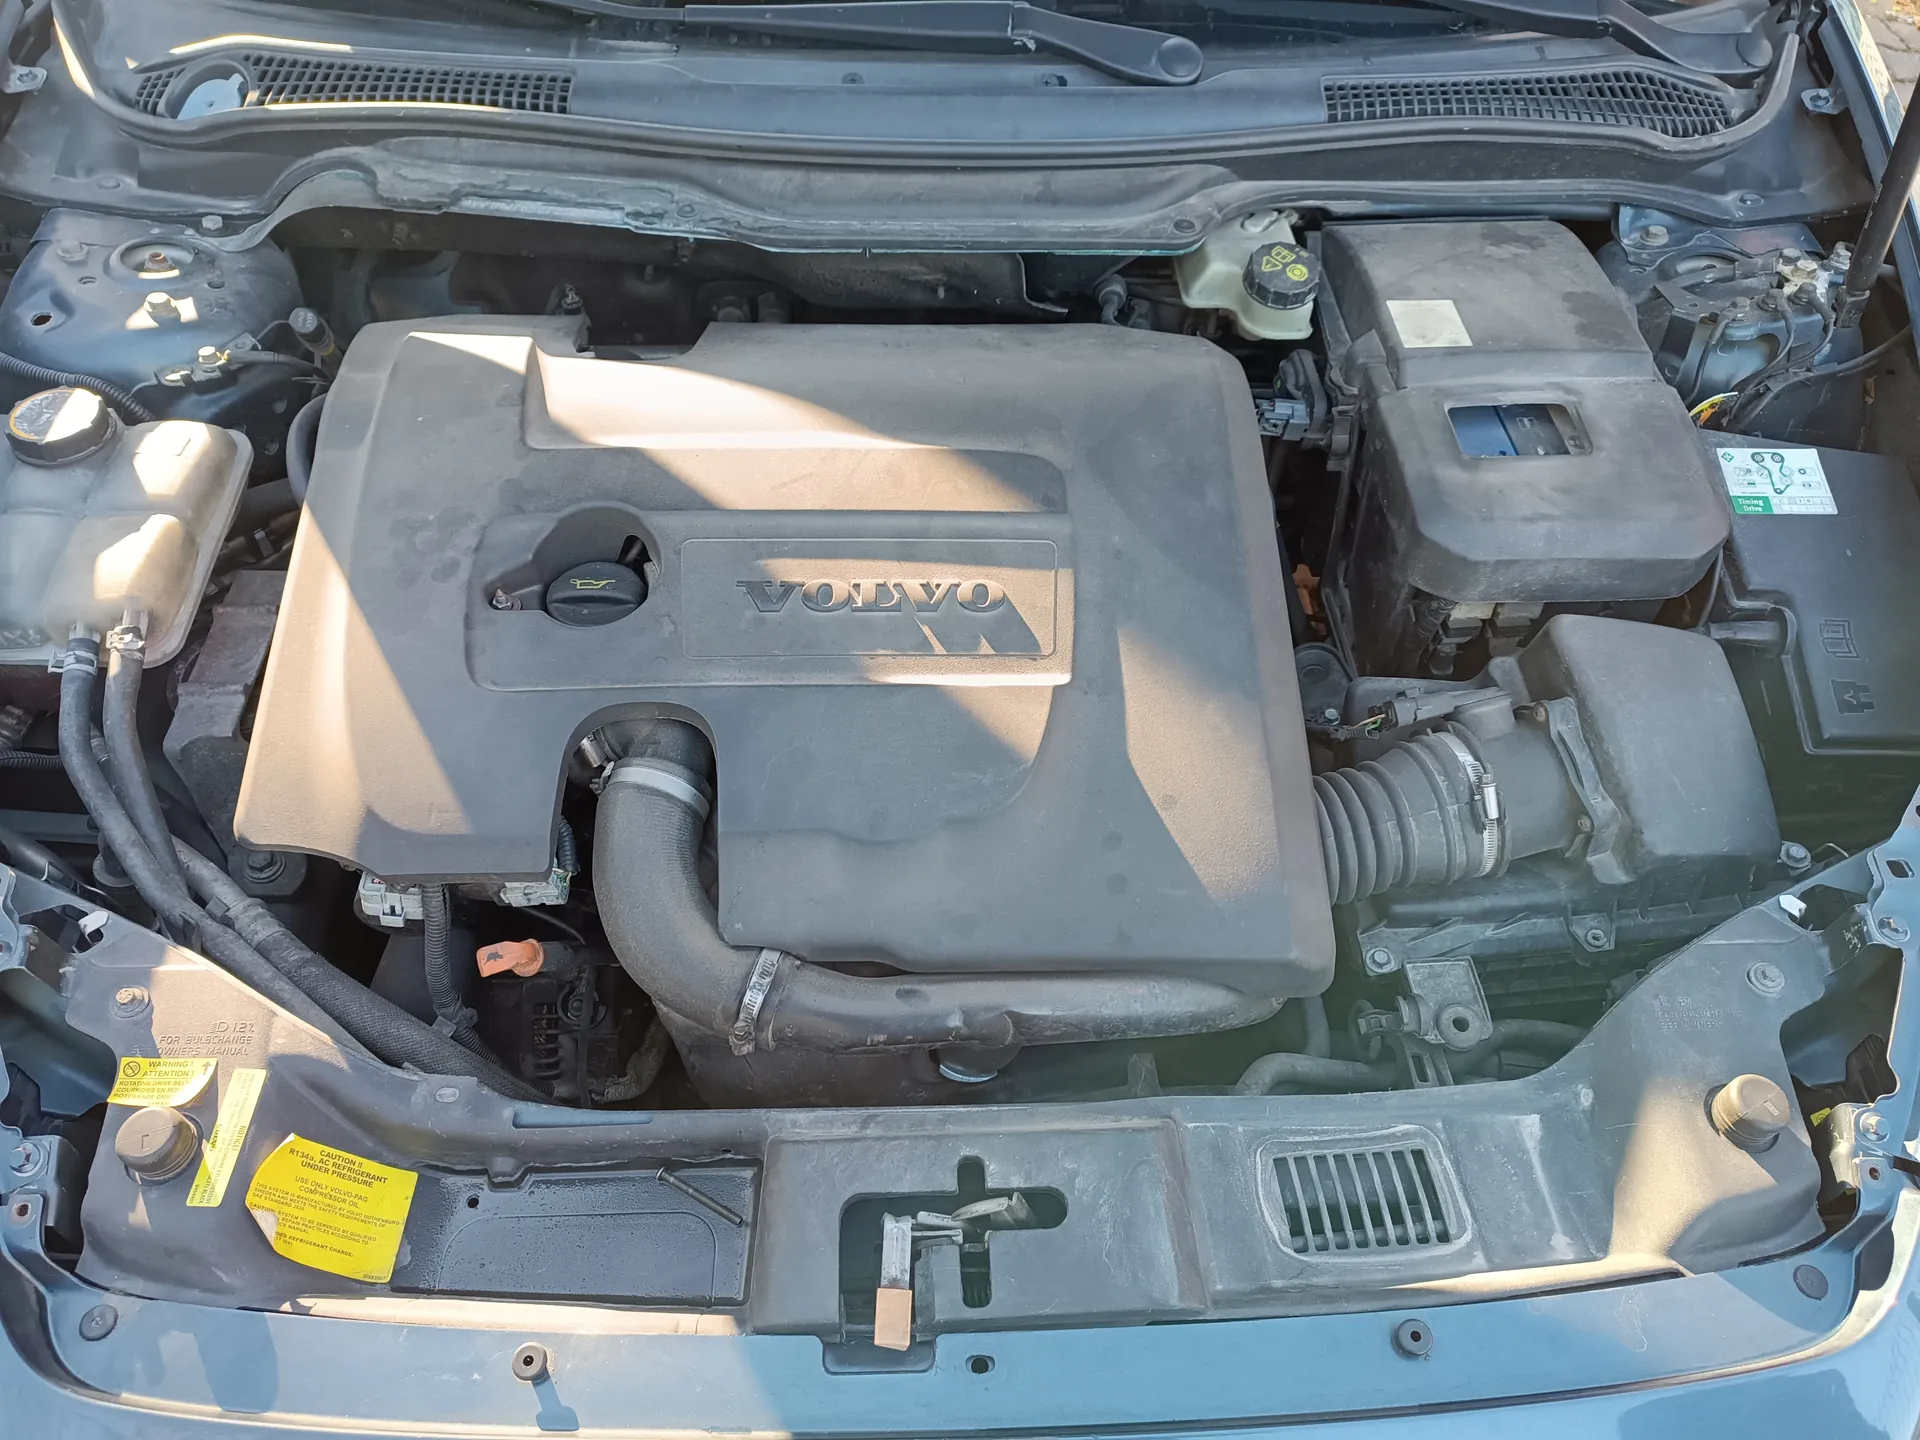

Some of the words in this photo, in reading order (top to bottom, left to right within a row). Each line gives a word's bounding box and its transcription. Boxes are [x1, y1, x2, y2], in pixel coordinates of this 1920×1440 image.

[1738, 498, 1764, 506] Timing
[736, 579, 1006, 614] VOLVO
[158, 1046, 200, 1055] OWNERS
[206, 1047, 248, 1055] MANUAL
[159, 1035, 180, 1044] FOR
[185, 1035, 252, 1044] BULBCHANGE
[289, 1148, 316, 1163] R134a,
[319, 1158, 329, 1166] AC
[332, 1161, 388, 1184] REFRIGERANT
[320, 1150, 356, 1166] CAUTION
[301, 1161, 330, 1174] UNDER
[332, 1170, 374, 1188] PRESSURE
[263, 1195, 292, 1207] STANDARD
[268, 1185, 289, 1196] SYSTEM
[296, 1194, 337, 1210] MANUFACTURED
[345, 1209, 362, 1217] VOLVO
[295, 1176, 309, 1184] USE
[311, 1180, 329, 1190] ONLY
[331, 1186, 368, 1202] VOLVO-PAG
[299, 1186, 347, 1204] COMPRESSOR
[253, 1187, 276, 1197] SWEDEN
[288, 1197, 307, 1206] MEETS
[318, 1206, 337, 1215] SAFETY
[338, 1212, 377, 1226] REQUIREMENTS
[277, 1210, 299, 1220] SYSTEM
[315, 1221, 341, 1232] SERVICED
[349, 1230, 376, 1242] QUALIFIED
[281, 1216, 300, 1226] REPAIR
[300, 1222, 330, 1234] PRACTICES
[330, 1230, 360, 1243] ACCORDING
[288, 1234, 328, 1250] REFRIGERANT
